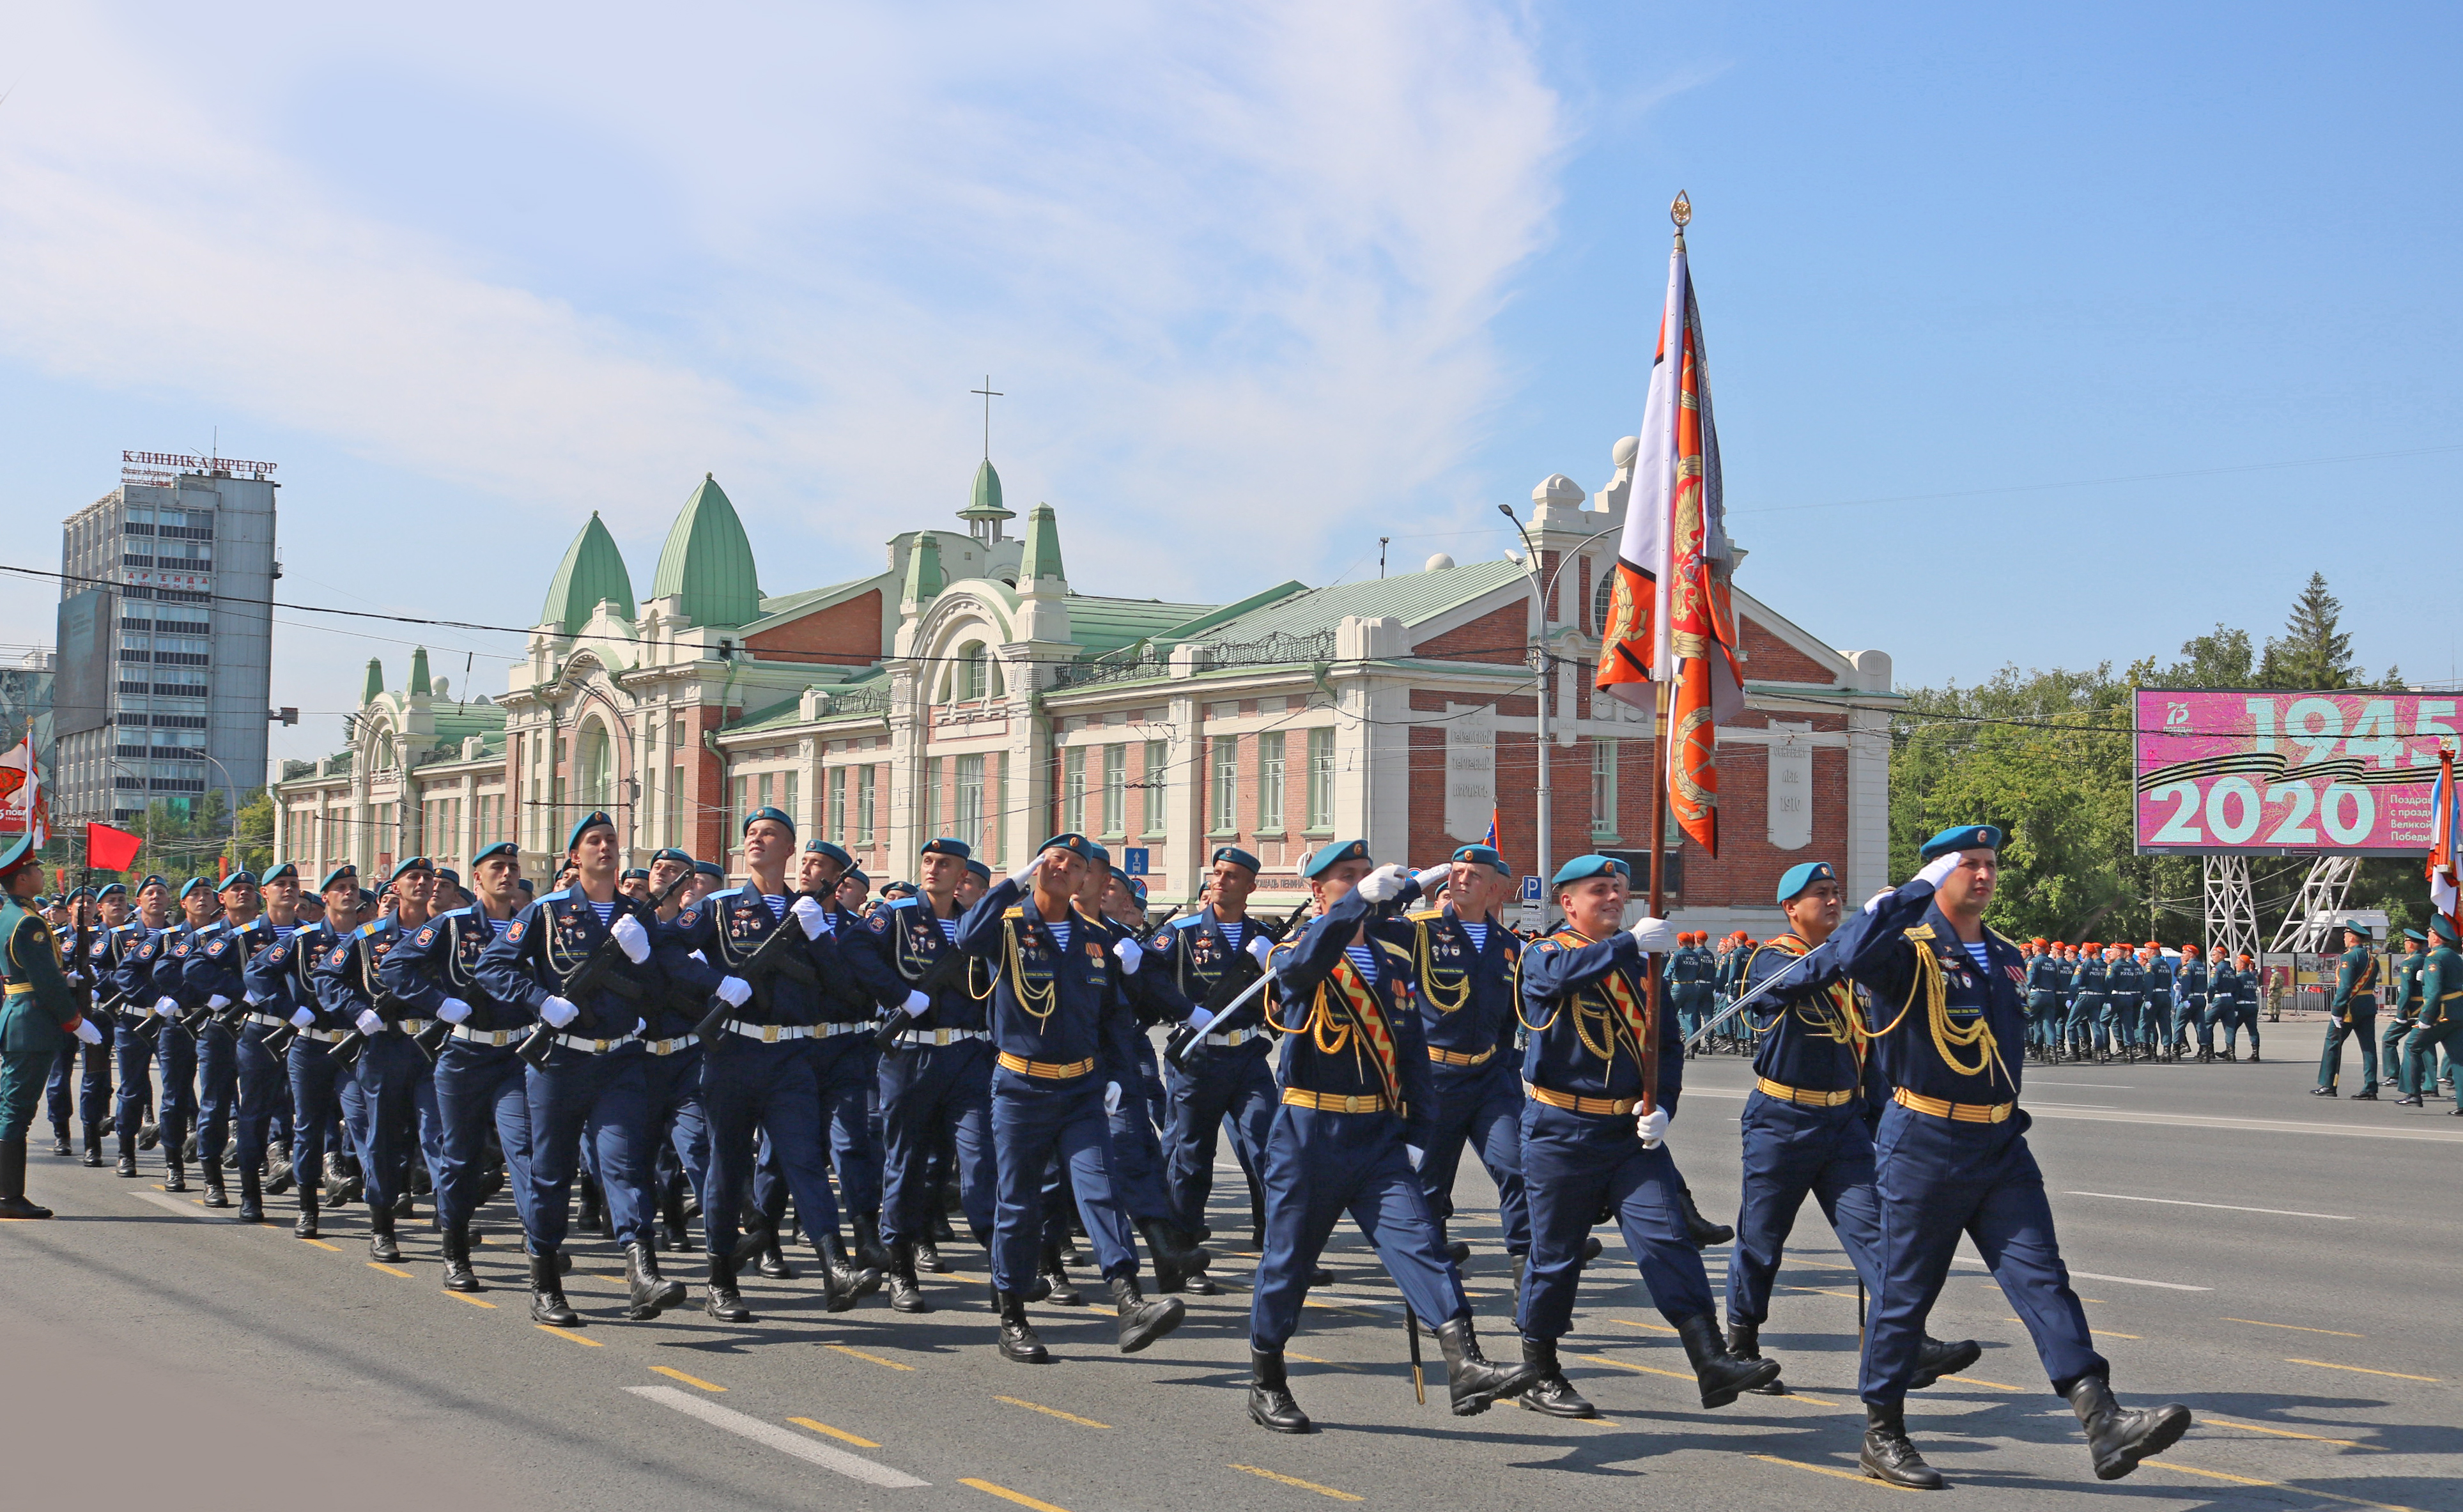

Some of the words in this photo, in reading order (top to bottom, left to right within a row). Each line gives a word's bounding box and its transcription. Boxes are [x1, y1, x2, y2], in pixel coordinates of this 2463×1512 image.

[122, 450, 208, 468] КЛИНИКА
[213, 458, 277, 474] ПРЕТОР
[128, 573, 208, 584] АРЕНДА
[2245, 697, 2461, 768] 1945
[1780, 796, 1801, 812] 1910
[2149, 776, 2375, 845] 2020
[2391, 819, 2432, 828] Великой
[1527, 878, 1538, 898] P
